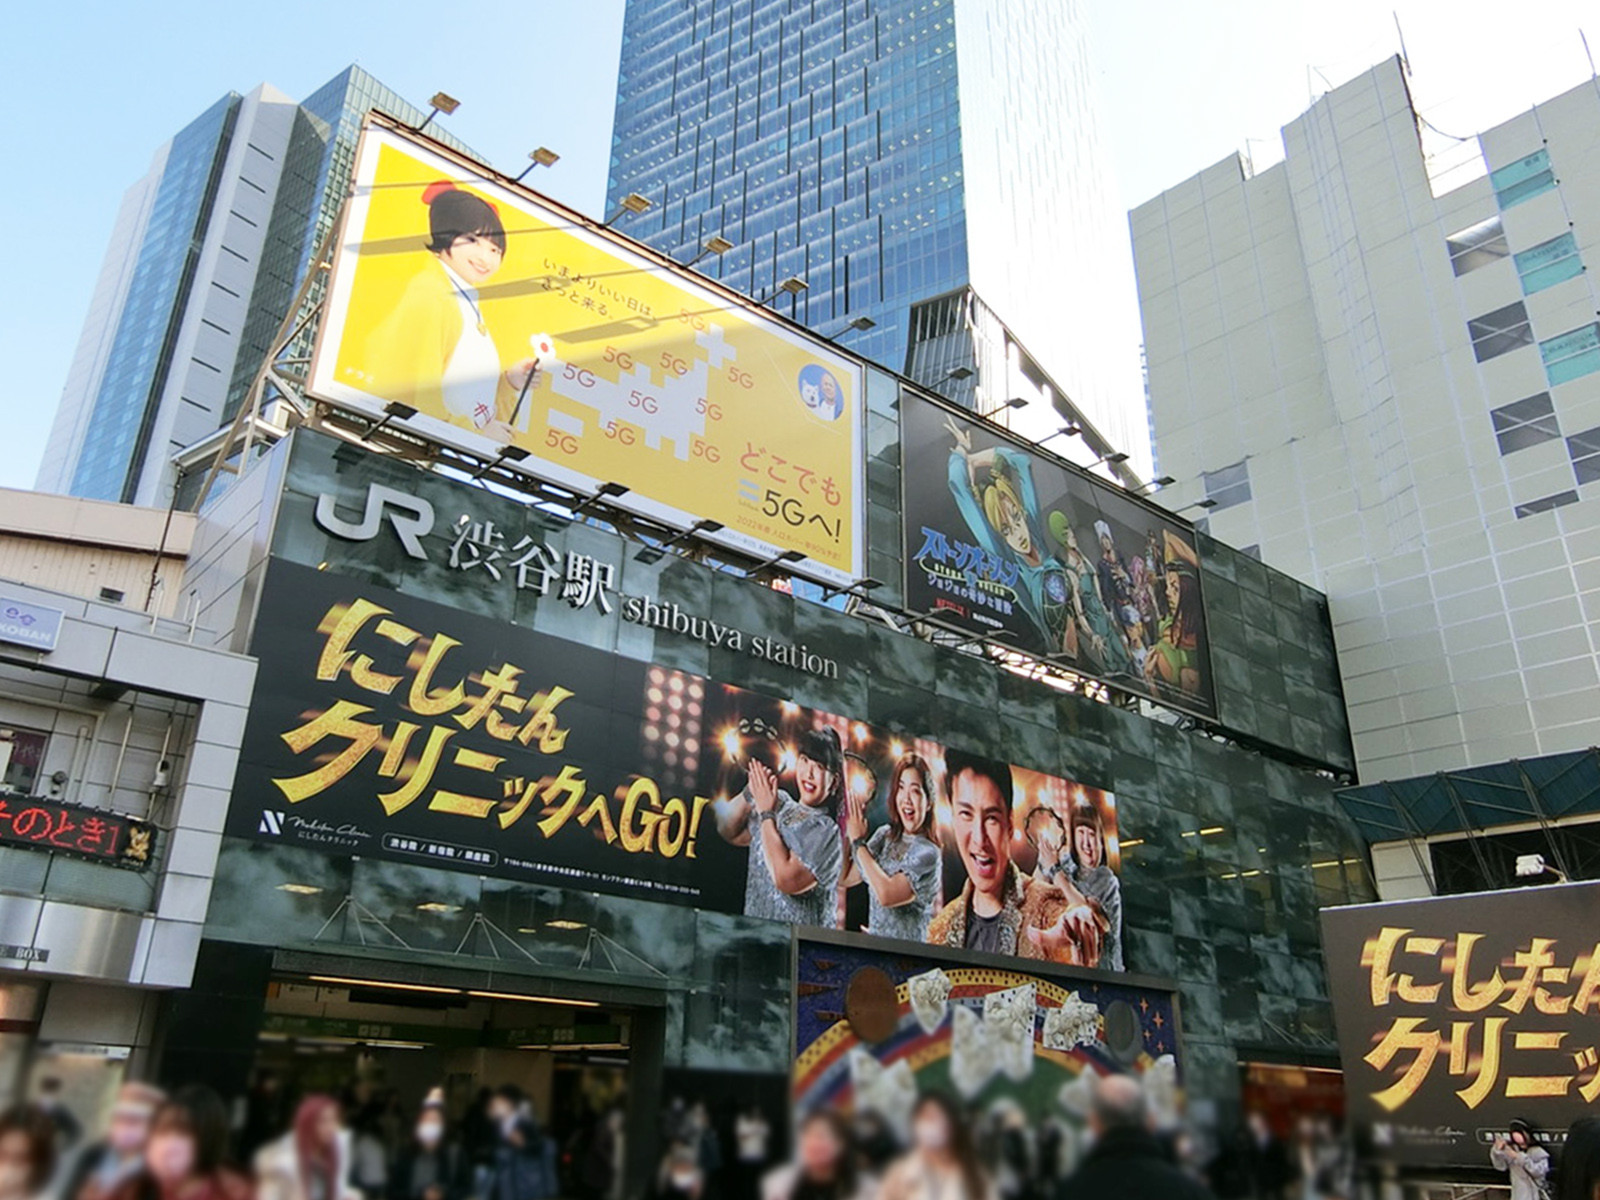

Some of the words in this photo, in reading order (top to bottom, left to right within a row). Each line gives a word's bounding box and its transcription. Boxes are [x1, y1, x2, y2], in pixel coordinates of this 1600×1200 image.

[678, 308, 705, 331] 5G
[603, 346, 633, 370] 5G
[660, 352, 688, 375] 5G
[562, 362, 596, 388] 5G
[728, 366, 754, 389] 5G
[628, 390, 658, 414] 5G
[695, 398, 723, 421] 5G
[545, 429, 578, 455] 5G
[604, 421, 635, 446] 5G
[692, 440, 720, 463] 5G
[740, 442, 841, 506] どこでも
[315, 482, 435, 560] JR
[449, 519, 613, 614] 渋谷駅
[627, 595, 742, 650] shibuya
[752, 636, 838, 679] station
[317, 597, 575, 755] にしたん
[15, 947, 40, 961] BOX
